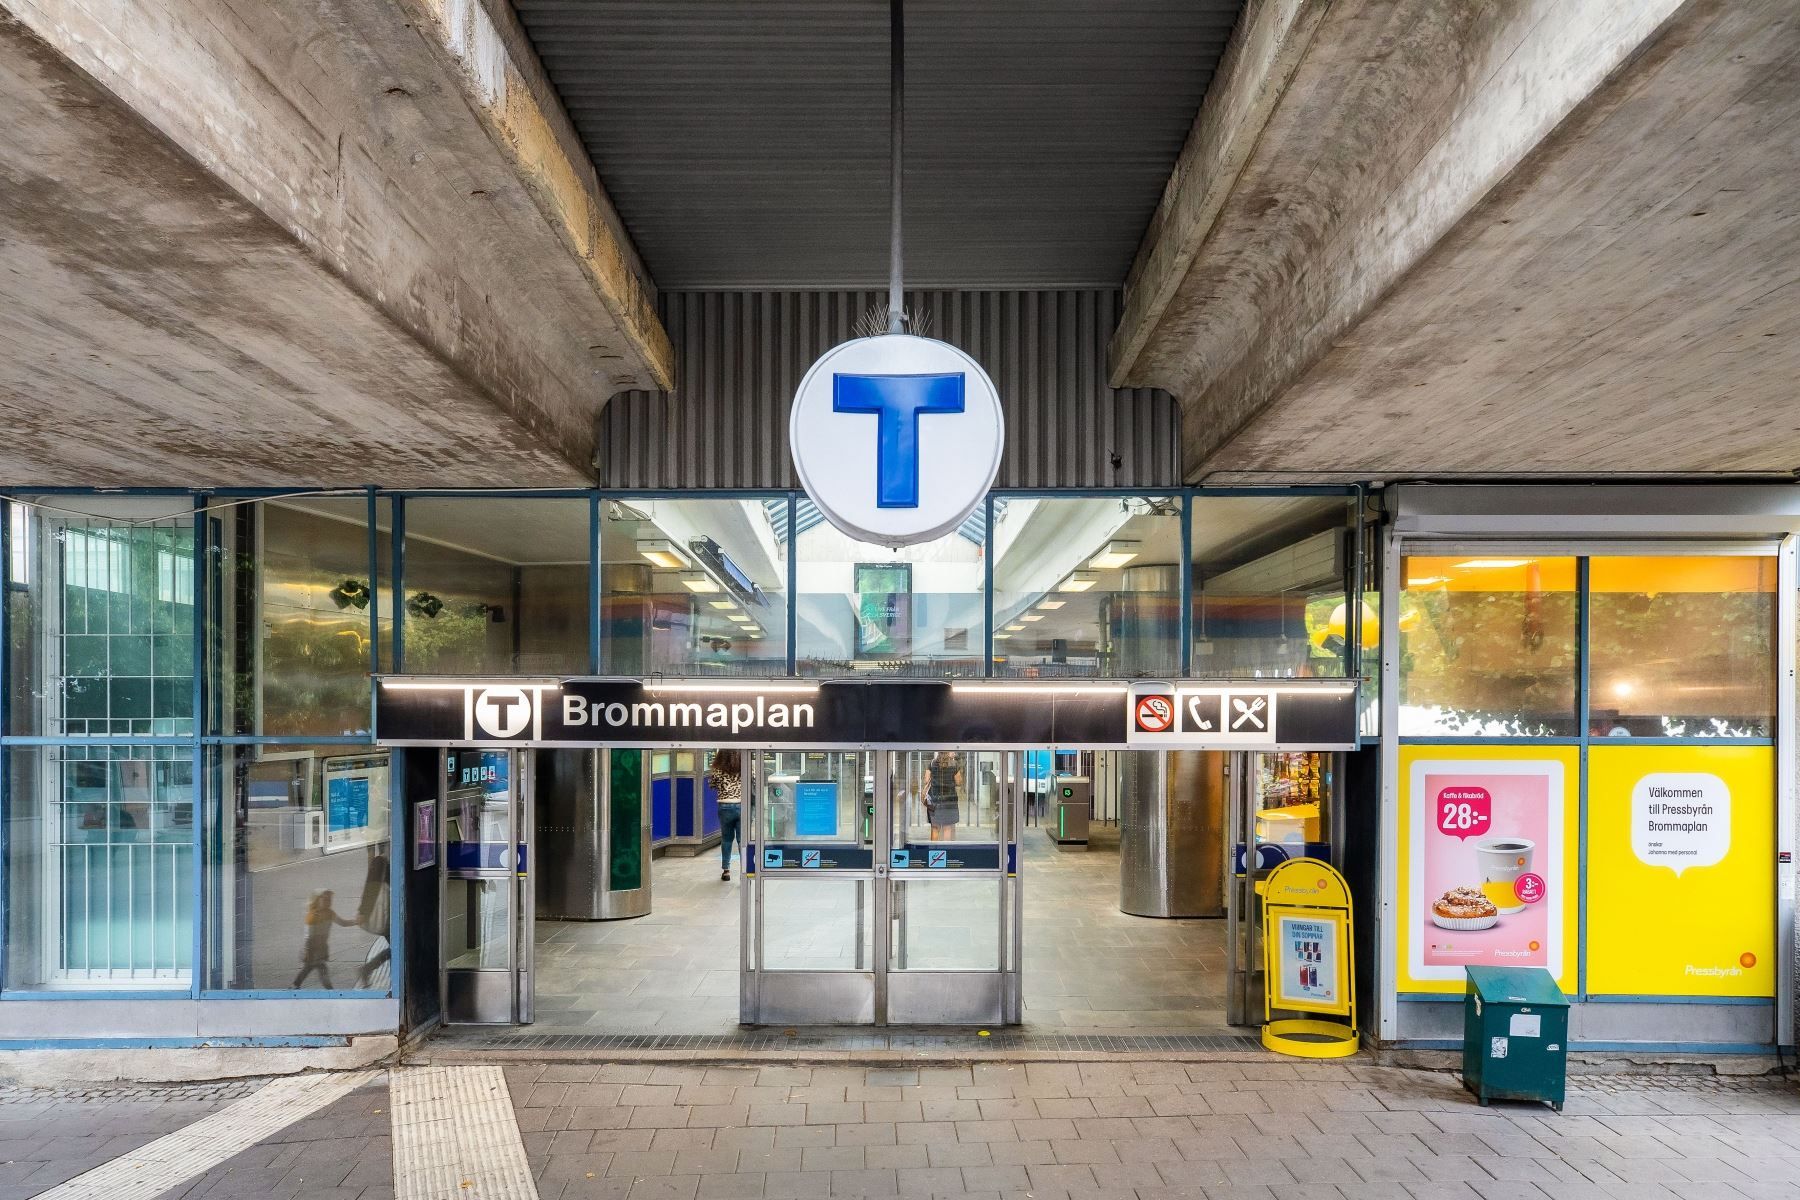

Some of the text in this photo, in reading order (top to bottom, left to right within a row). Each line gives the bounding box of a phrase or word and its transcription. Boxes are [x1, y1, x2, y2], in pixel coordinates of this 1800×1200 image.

[833, 372, 966, 509] T
[486, 695, 815, 734] T Brommaplan
[1648, 787, 1703, 798] Välkommen
[1442, 803, 1488, 829] 28:-
[1648, 803, 1713, 817] till Pressbyrån
[1648, 820, 1708, 834] Brommaplan
[1525, 878, 1539, 889] 3:-
[1684, 965, 1742, 978] Pressbyrån
